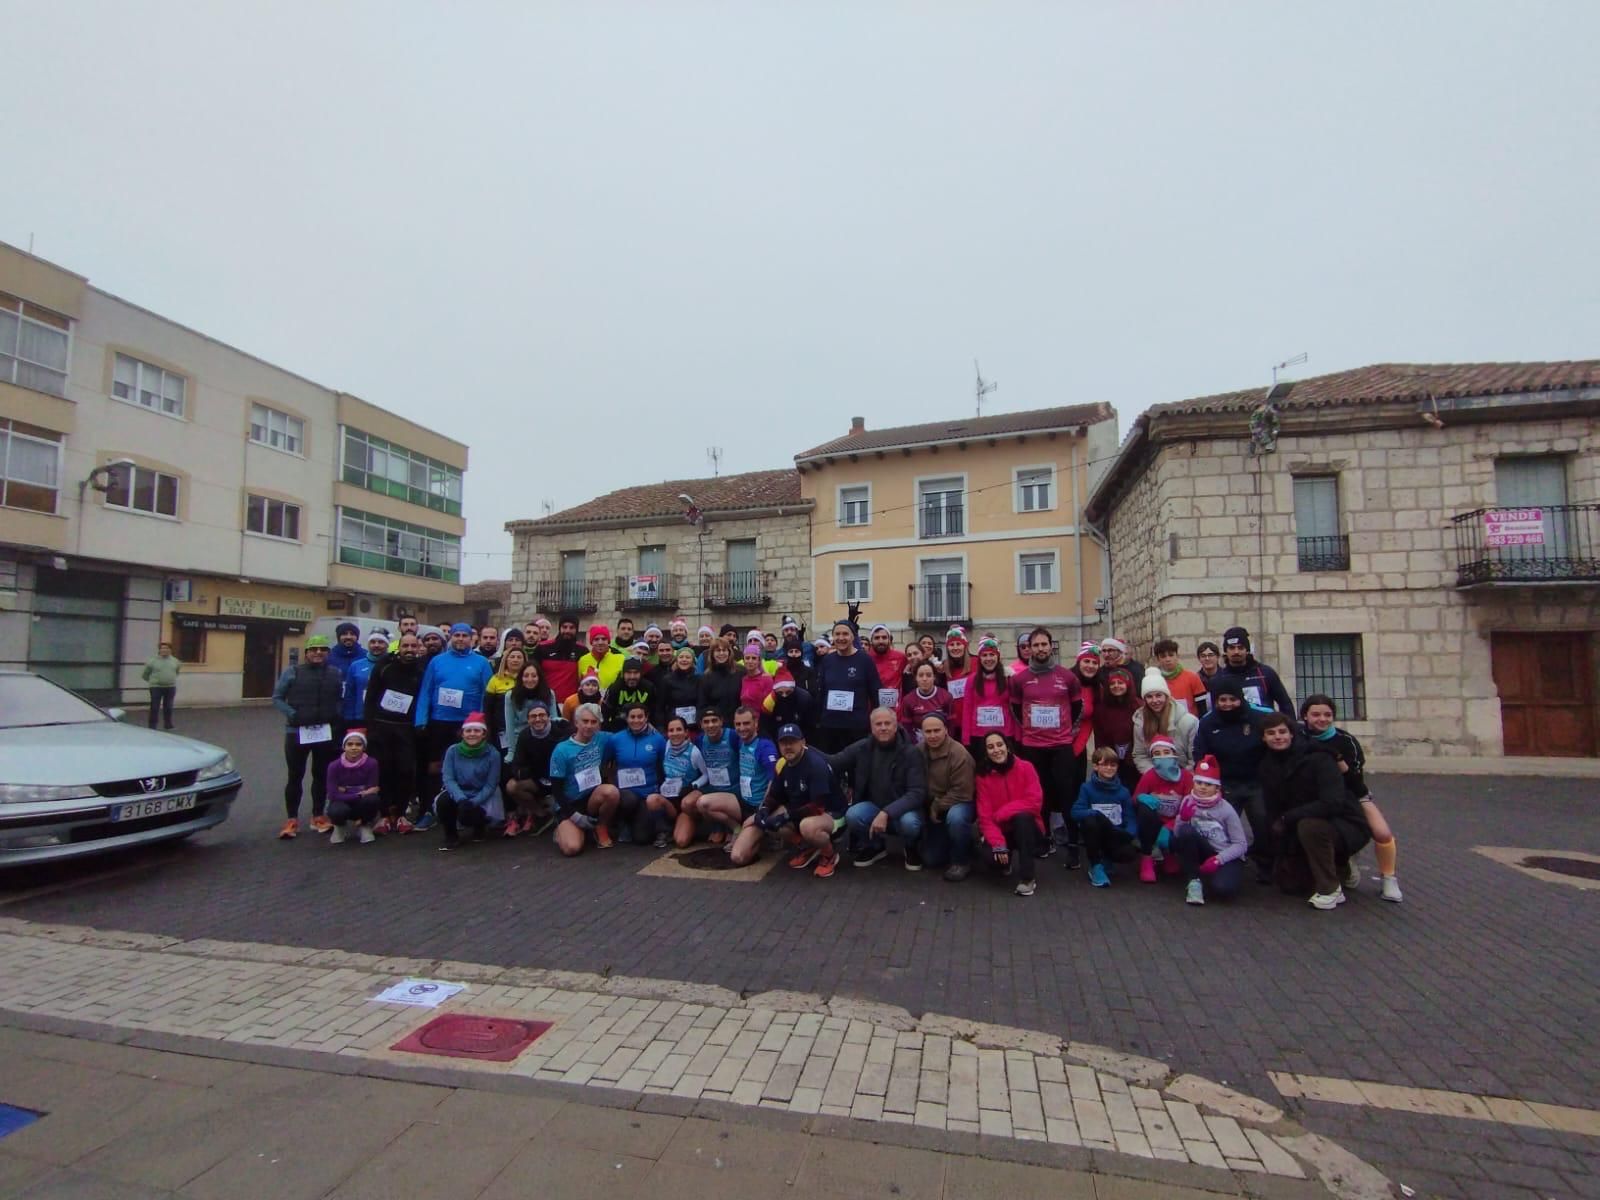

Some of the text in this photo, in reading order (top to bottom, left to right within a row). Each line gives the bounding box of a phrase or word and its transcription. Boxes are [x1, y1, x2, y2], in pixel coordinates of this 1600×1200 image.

[1489, 511, 1537, 522] VENDE
[124, 794, 192, 818] 3168 CMX
